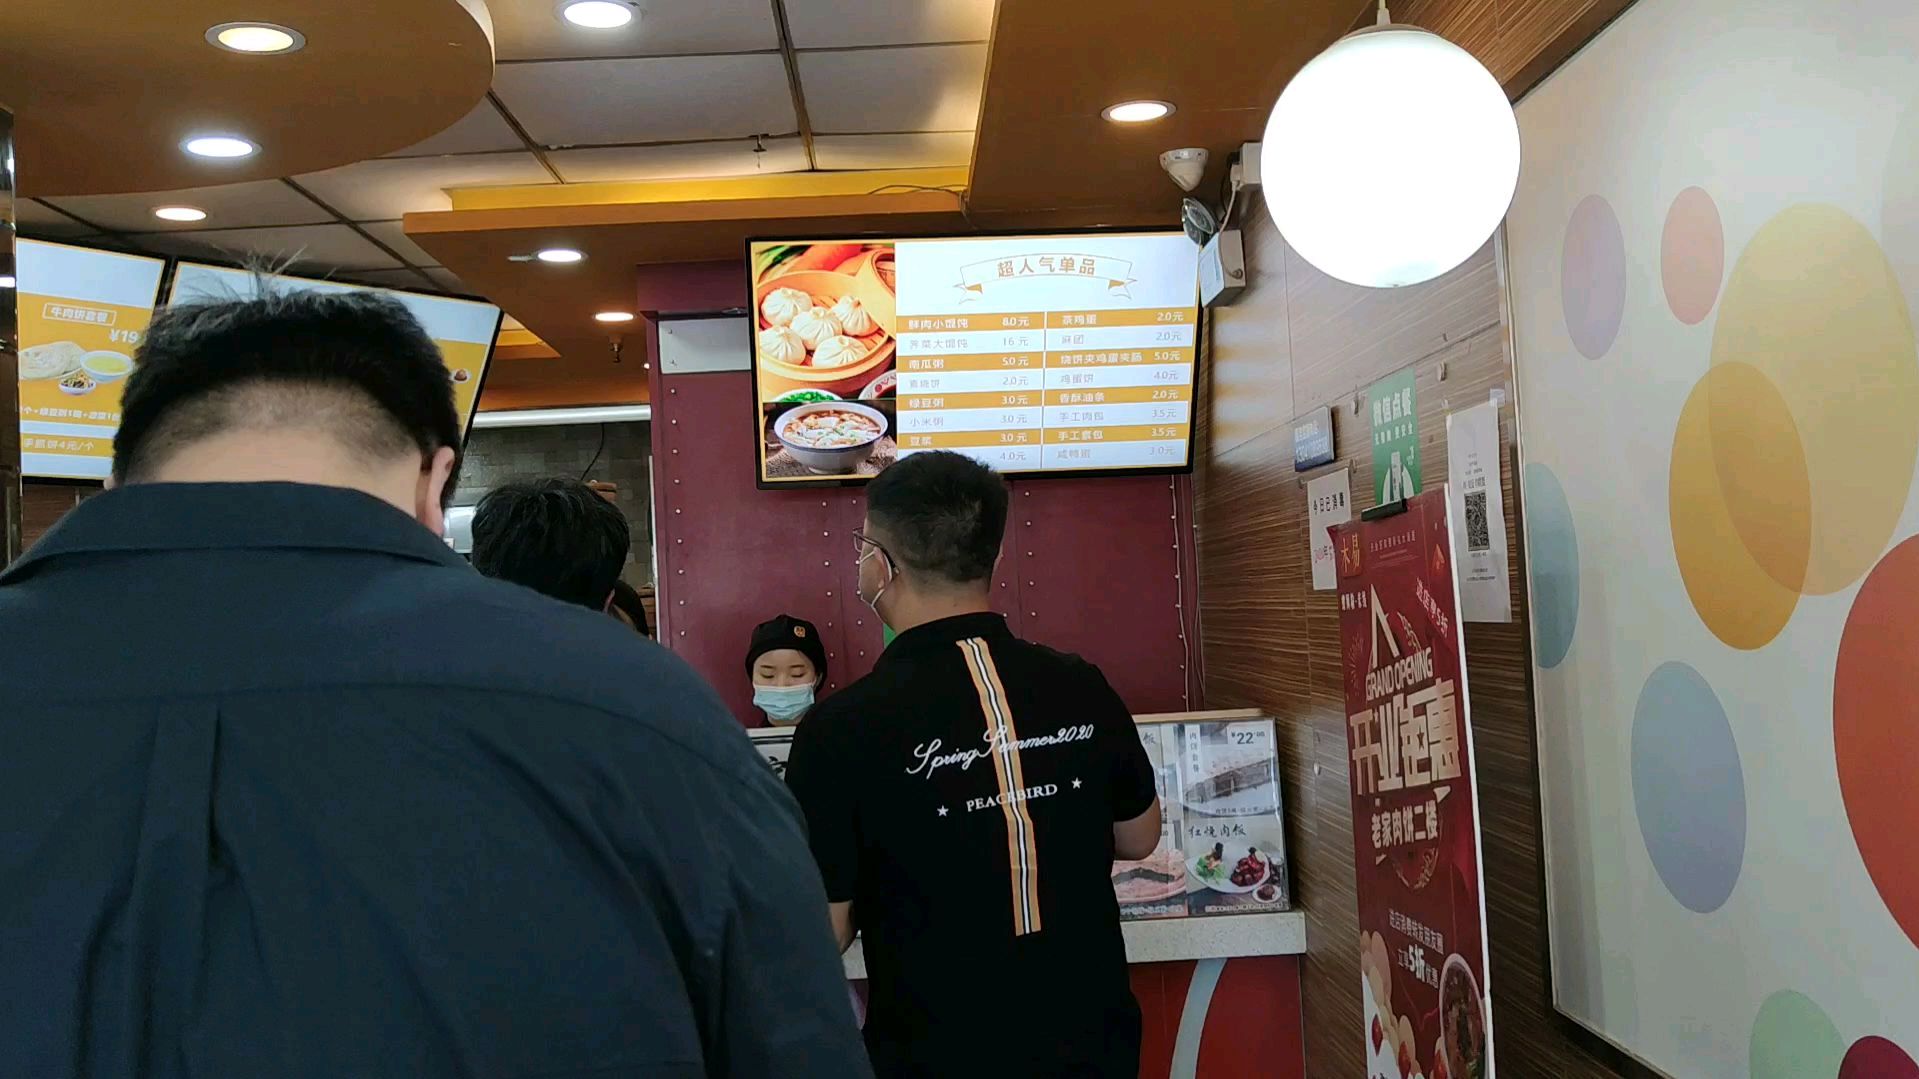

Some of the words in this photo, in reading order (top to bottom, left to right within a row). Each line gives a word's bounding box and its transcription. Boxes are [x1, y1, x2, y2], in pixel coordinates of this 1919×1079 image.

[998, 256, 1096, 278] 超人气单品
[909, 358, 944, 369] 南瓜粥
[909, 397, 944, 408] 绿豆粥
[910, 416, 944, 427] 小米粥
[1059, 411, 1104, 422] 手工肉包
[1366, 666, 1394, 702] GRAND
[1394, 647, 1433, 691] OPENING
[966, 783, 1058, 812] PEACEBIRD
